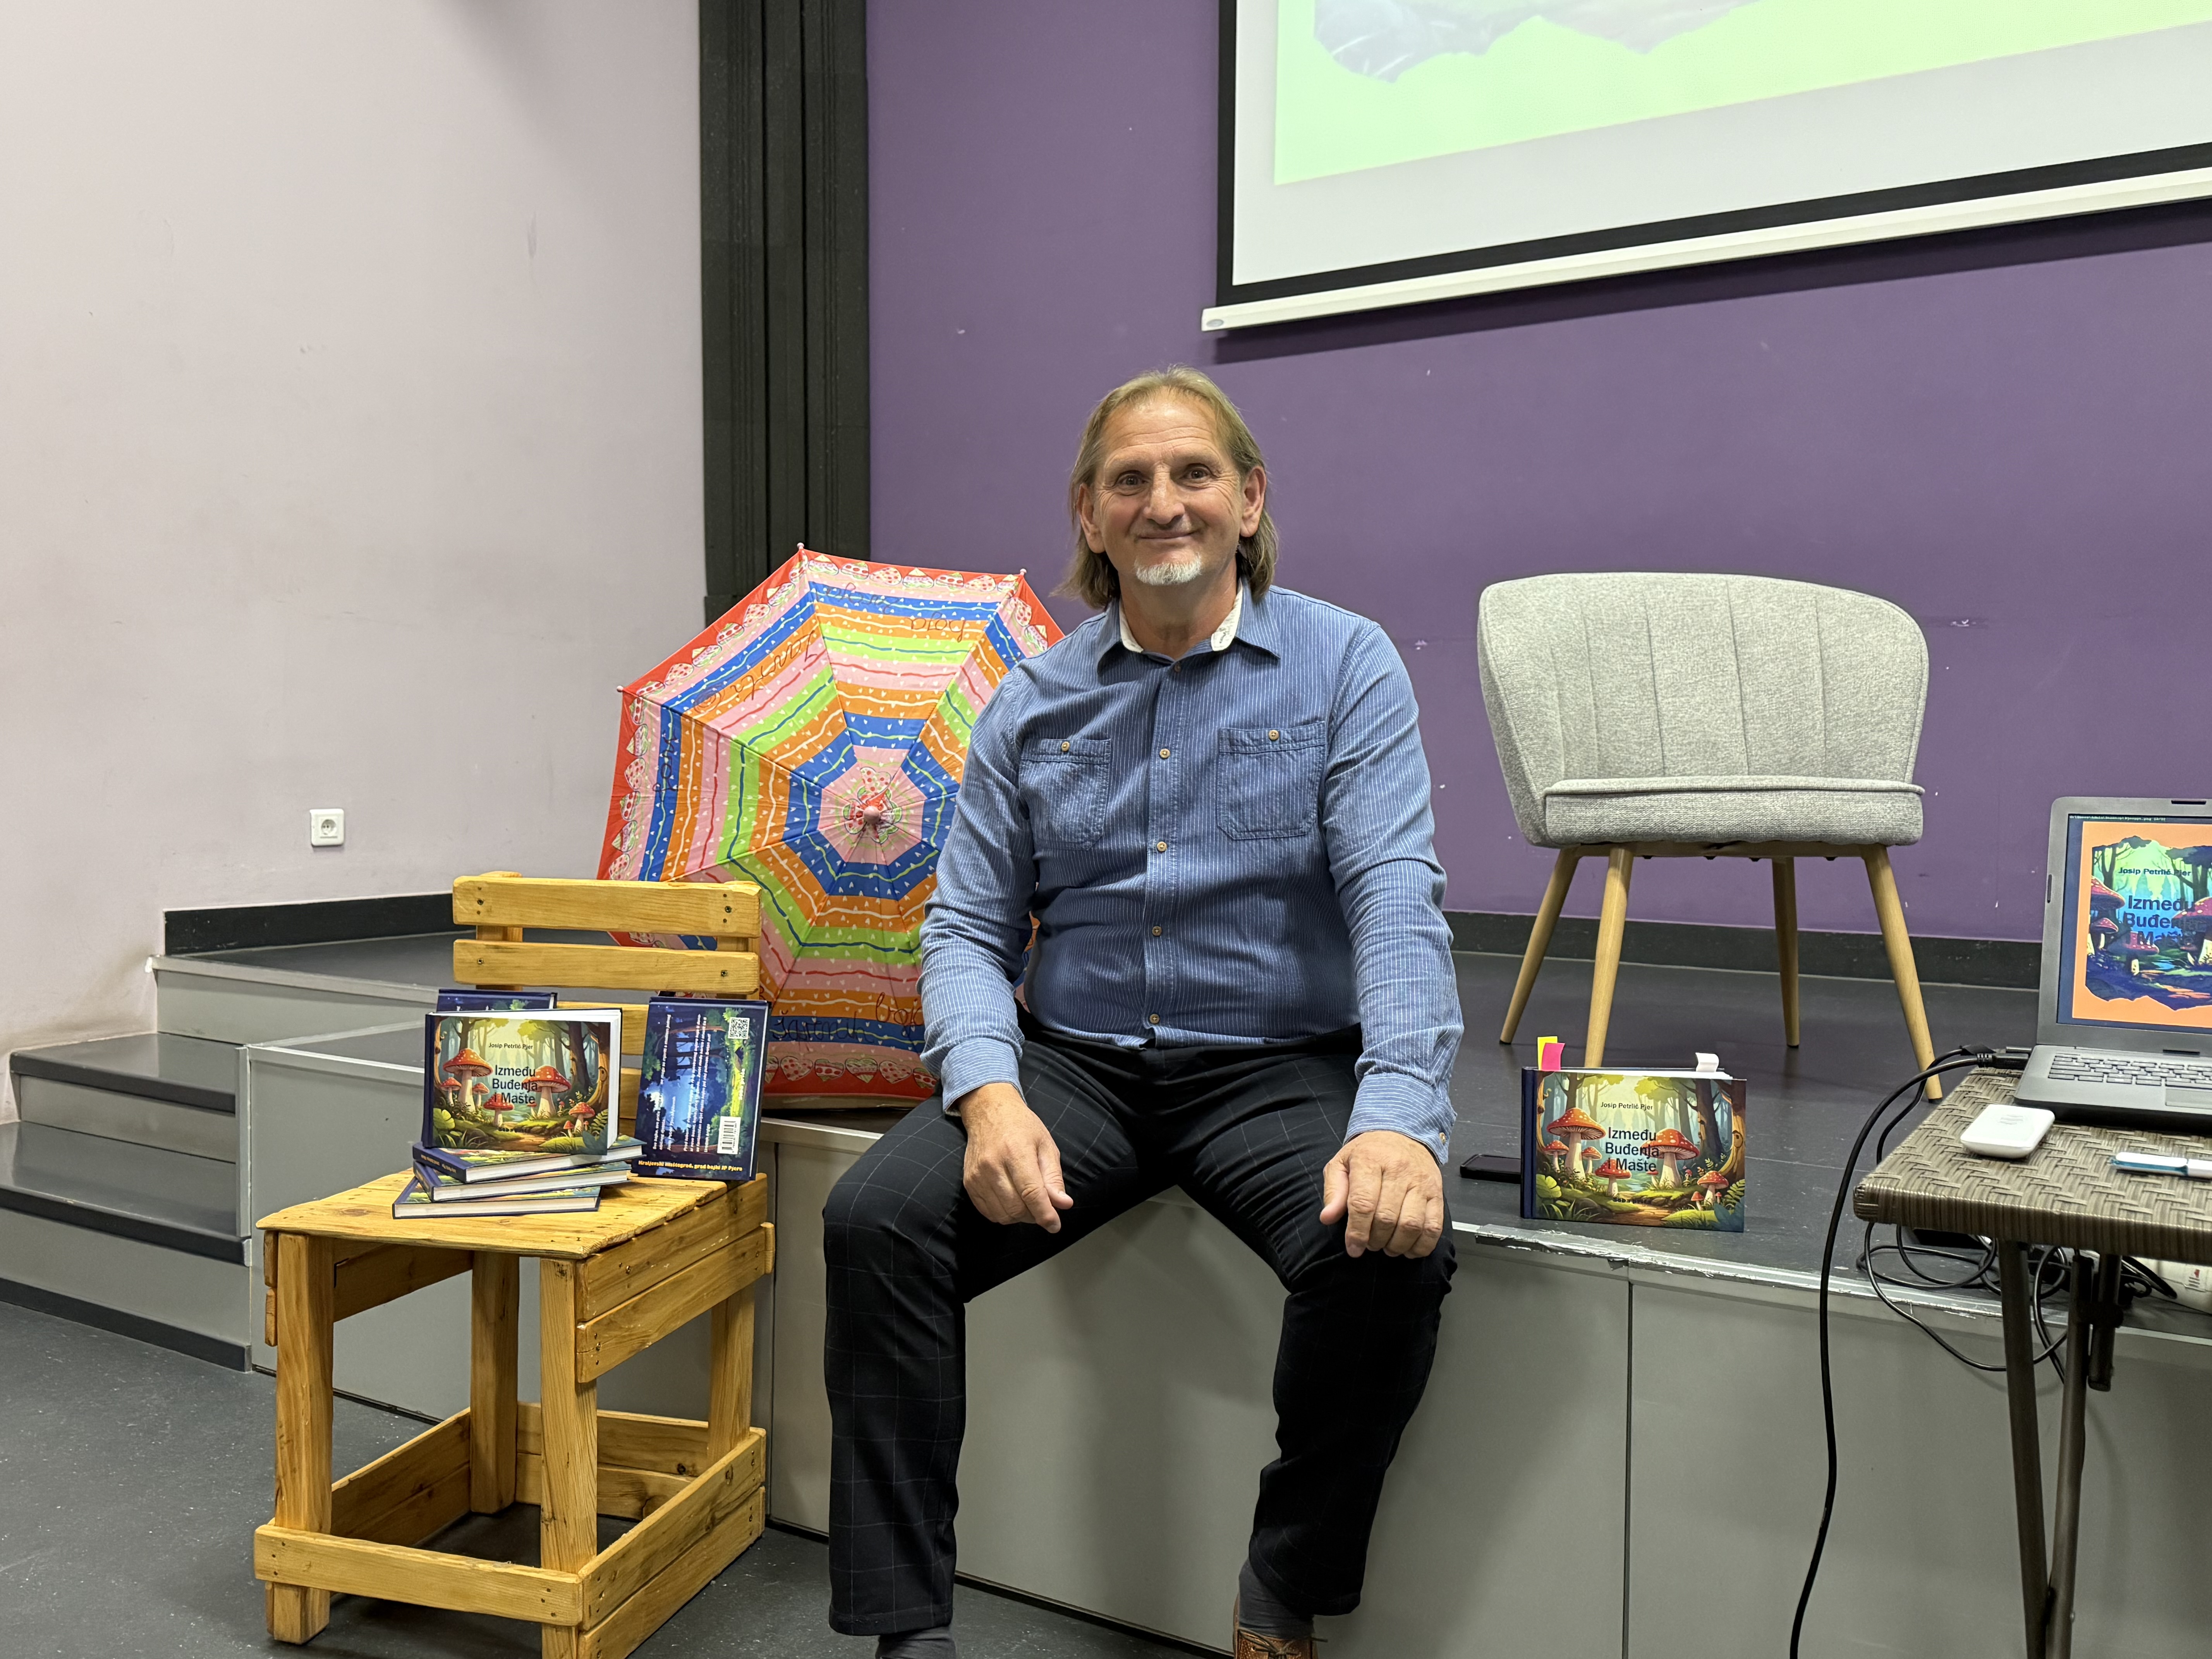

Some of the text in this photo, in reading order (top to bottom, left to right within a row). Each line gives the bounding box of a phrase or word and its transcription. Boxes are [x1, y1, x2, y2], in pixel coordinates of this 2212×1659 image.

[2118, 867, 2141, 875] Josip
[495, 1065, 536, 1077] Između
[492, 1078, 538, 1093] Buđenja
[501, 1092, 535, 1104] Mašte
[1609, 1127, 1656, 1141] Između
[1606, 1142, 1659, 1159] Buđenja
[1616, 1158, 1657, 1172] Mašte
